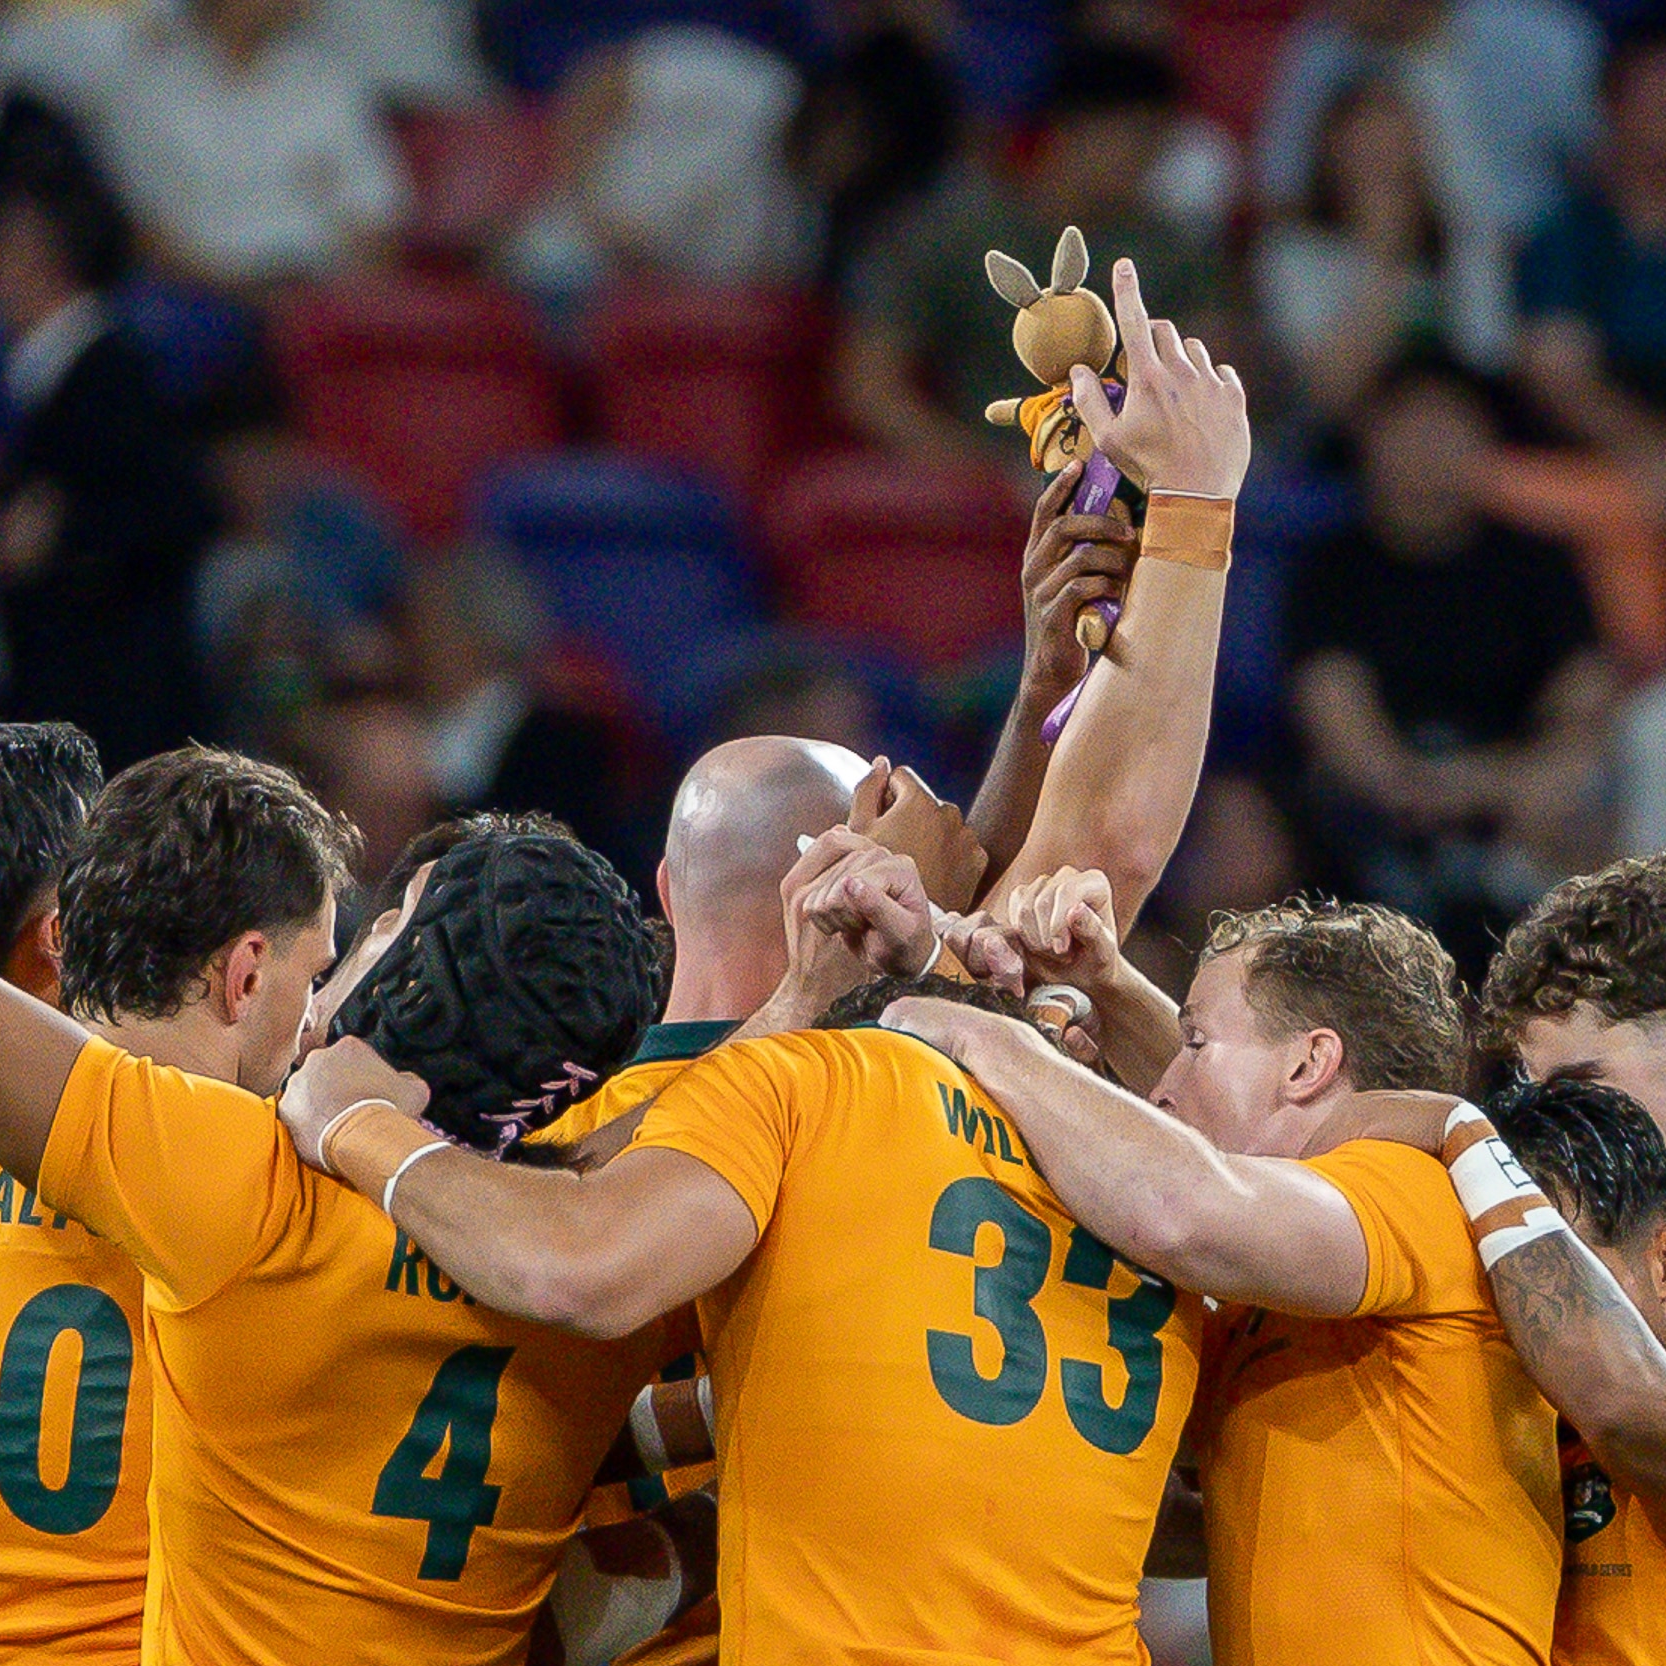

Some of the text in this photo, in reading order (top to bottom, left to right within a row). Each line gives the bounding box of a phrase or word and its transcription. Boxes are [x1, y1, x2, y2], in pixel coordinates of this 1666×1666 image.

[936, 1080, 1039, 1174] WIL
[926, 1176, 1175, 1455] 33
[371, 1345, 516, 1582] 4
